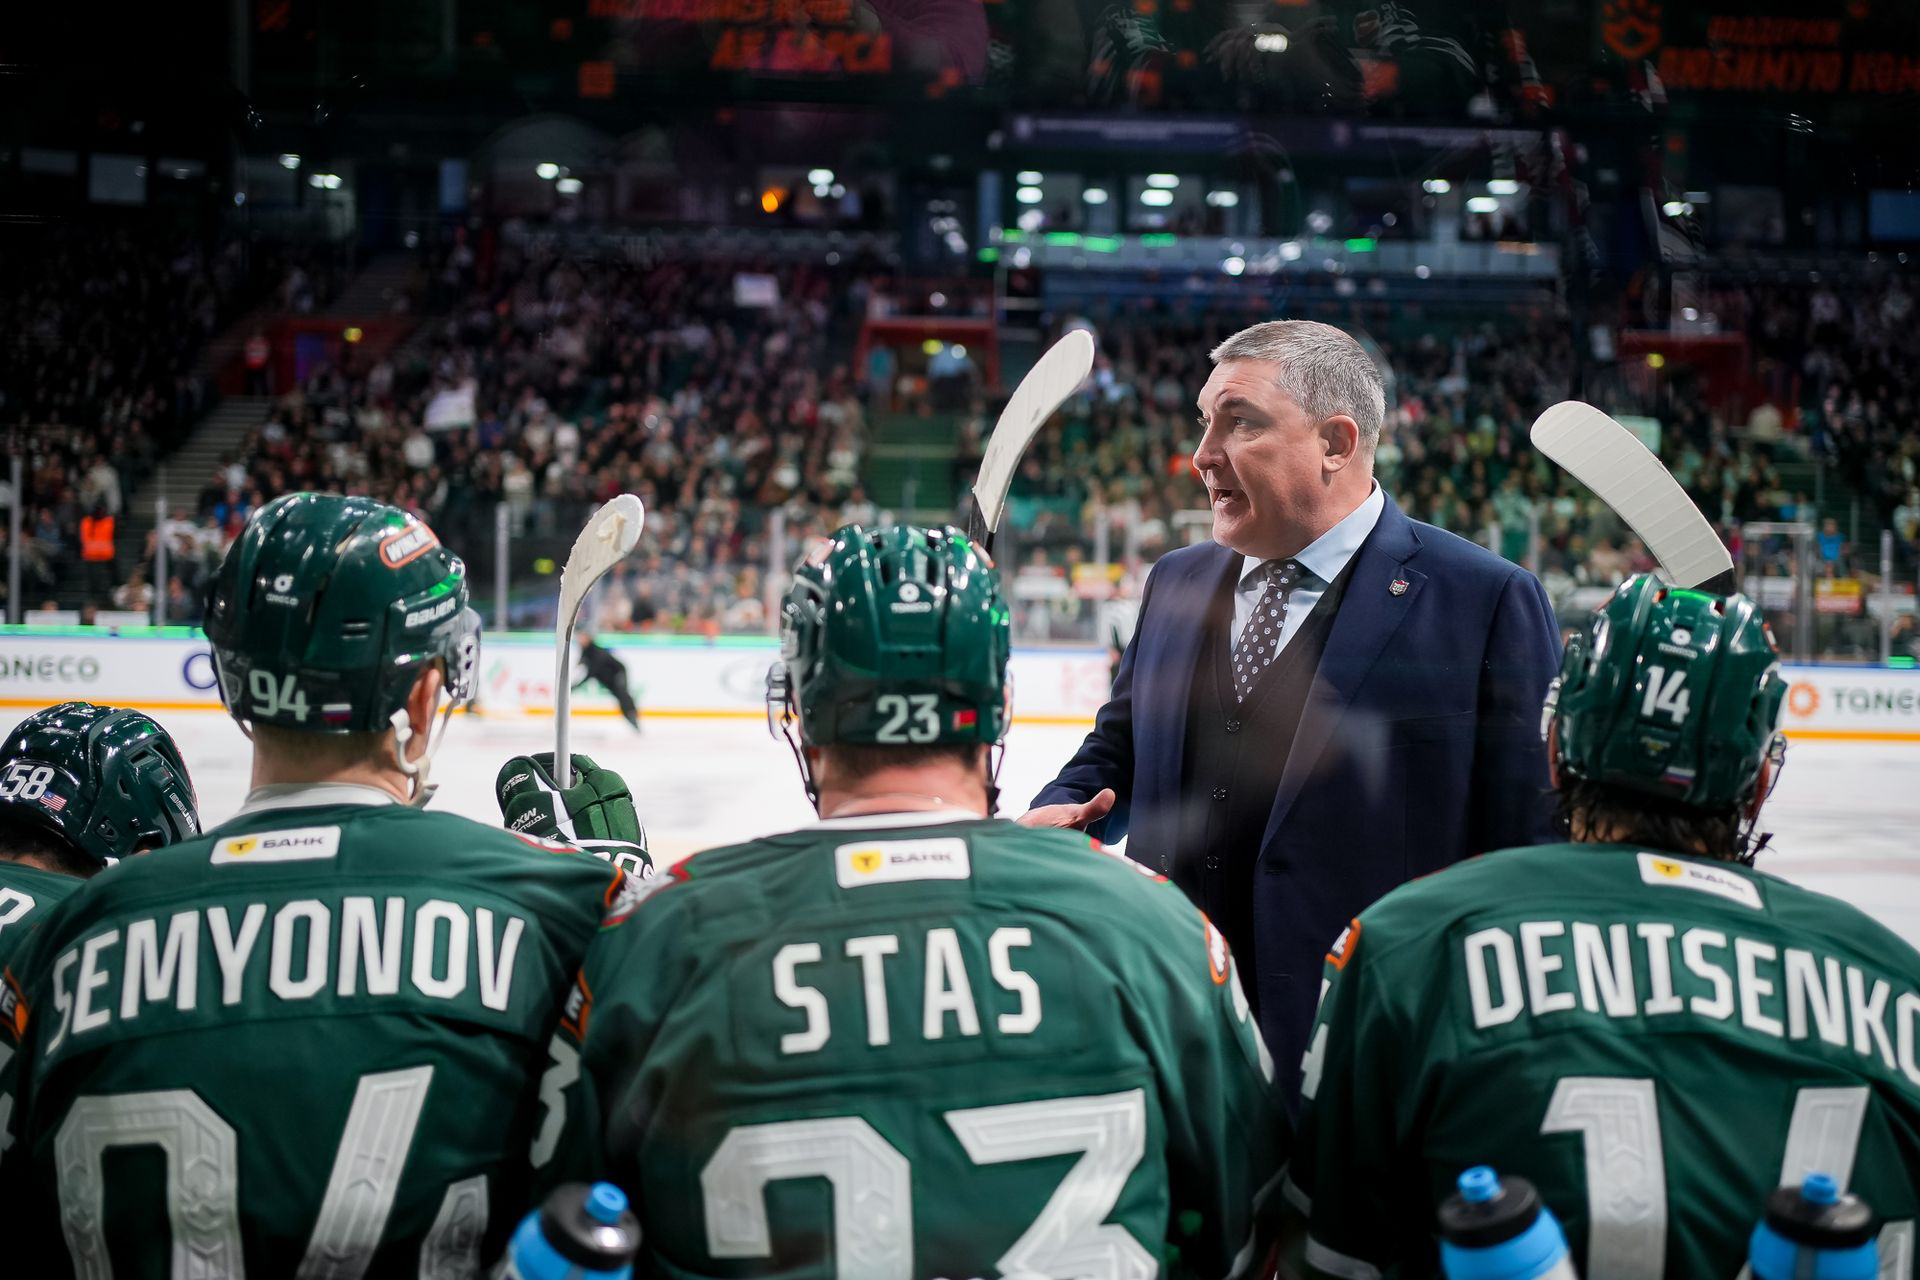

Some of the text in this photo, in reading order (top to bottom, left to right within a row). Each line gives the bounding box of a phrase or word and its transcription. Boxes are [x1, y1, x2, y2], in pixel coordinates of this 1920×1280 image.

[249, 669, 309, 723] 94
[876, 694, 941, 743] 23
[1640, 665, 1690, 724] 14
[1834, 687, 1920, 716] TANE
[0, 764, 56, 800] 58
[262, 834, 324, 849] БАНК
[45, 896, 525, 1056] SEMYONOV
[772, 926, 1042, 1054] STAS
